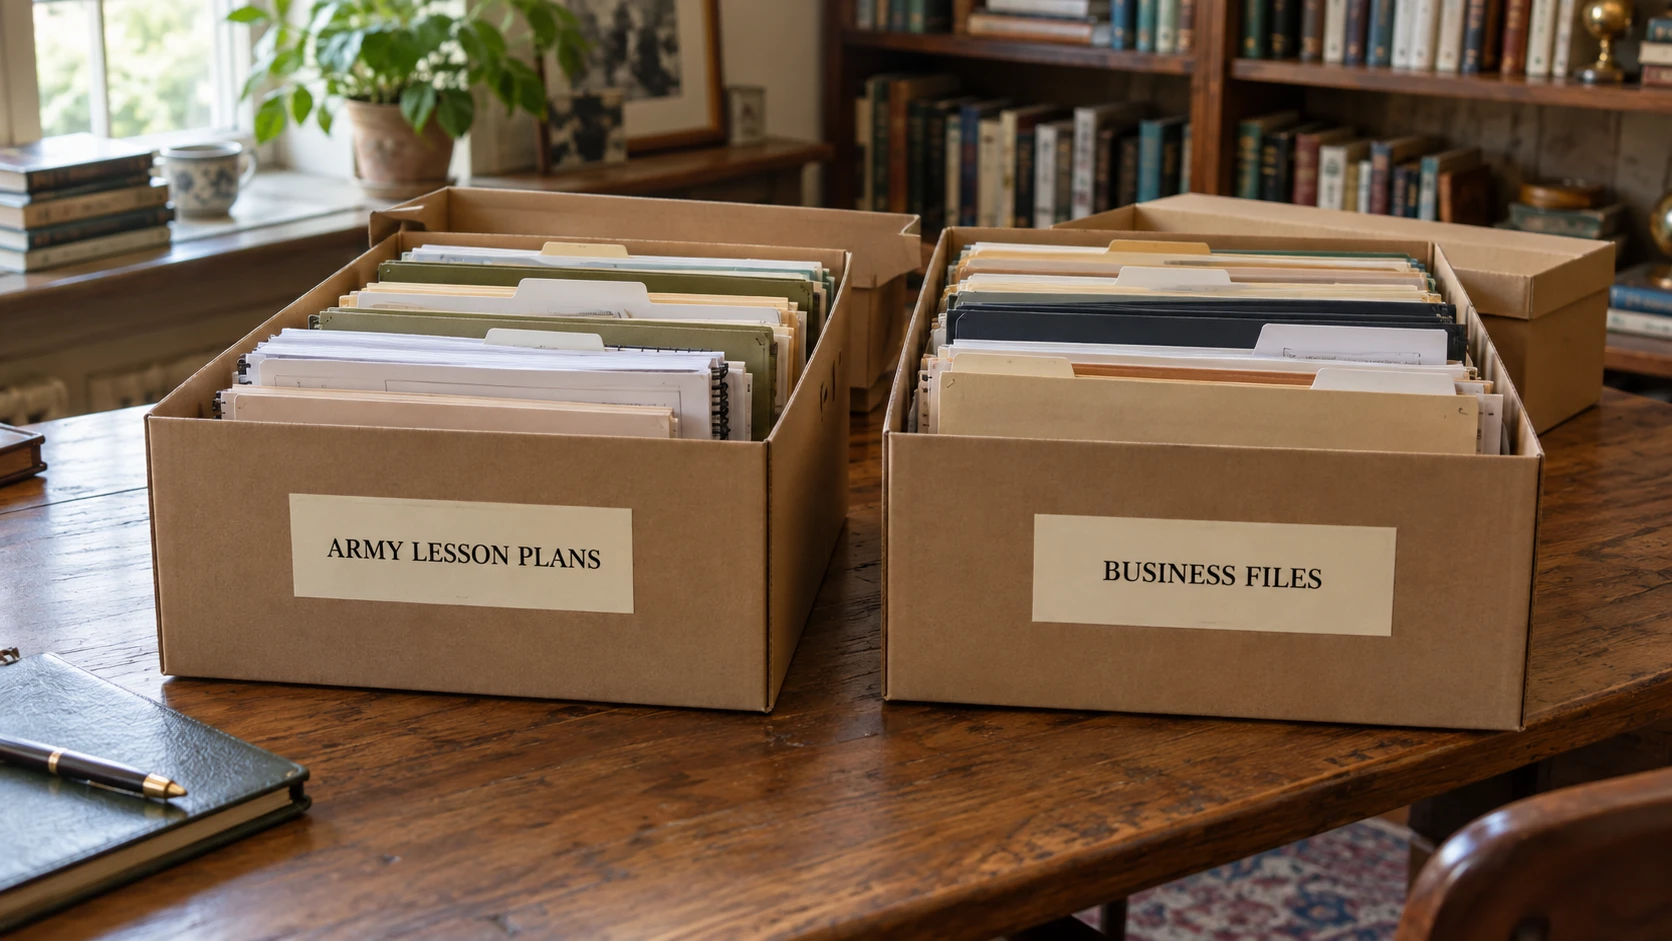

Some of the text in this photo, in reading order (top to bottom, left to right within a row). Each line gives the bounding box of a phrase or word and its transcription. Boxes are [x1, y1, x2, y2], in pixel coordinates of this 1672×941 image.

[327, 538, 602, 570] ARMY LESSON PLANS
[1103, 560, 1323, 590] BUSINESS FILES
